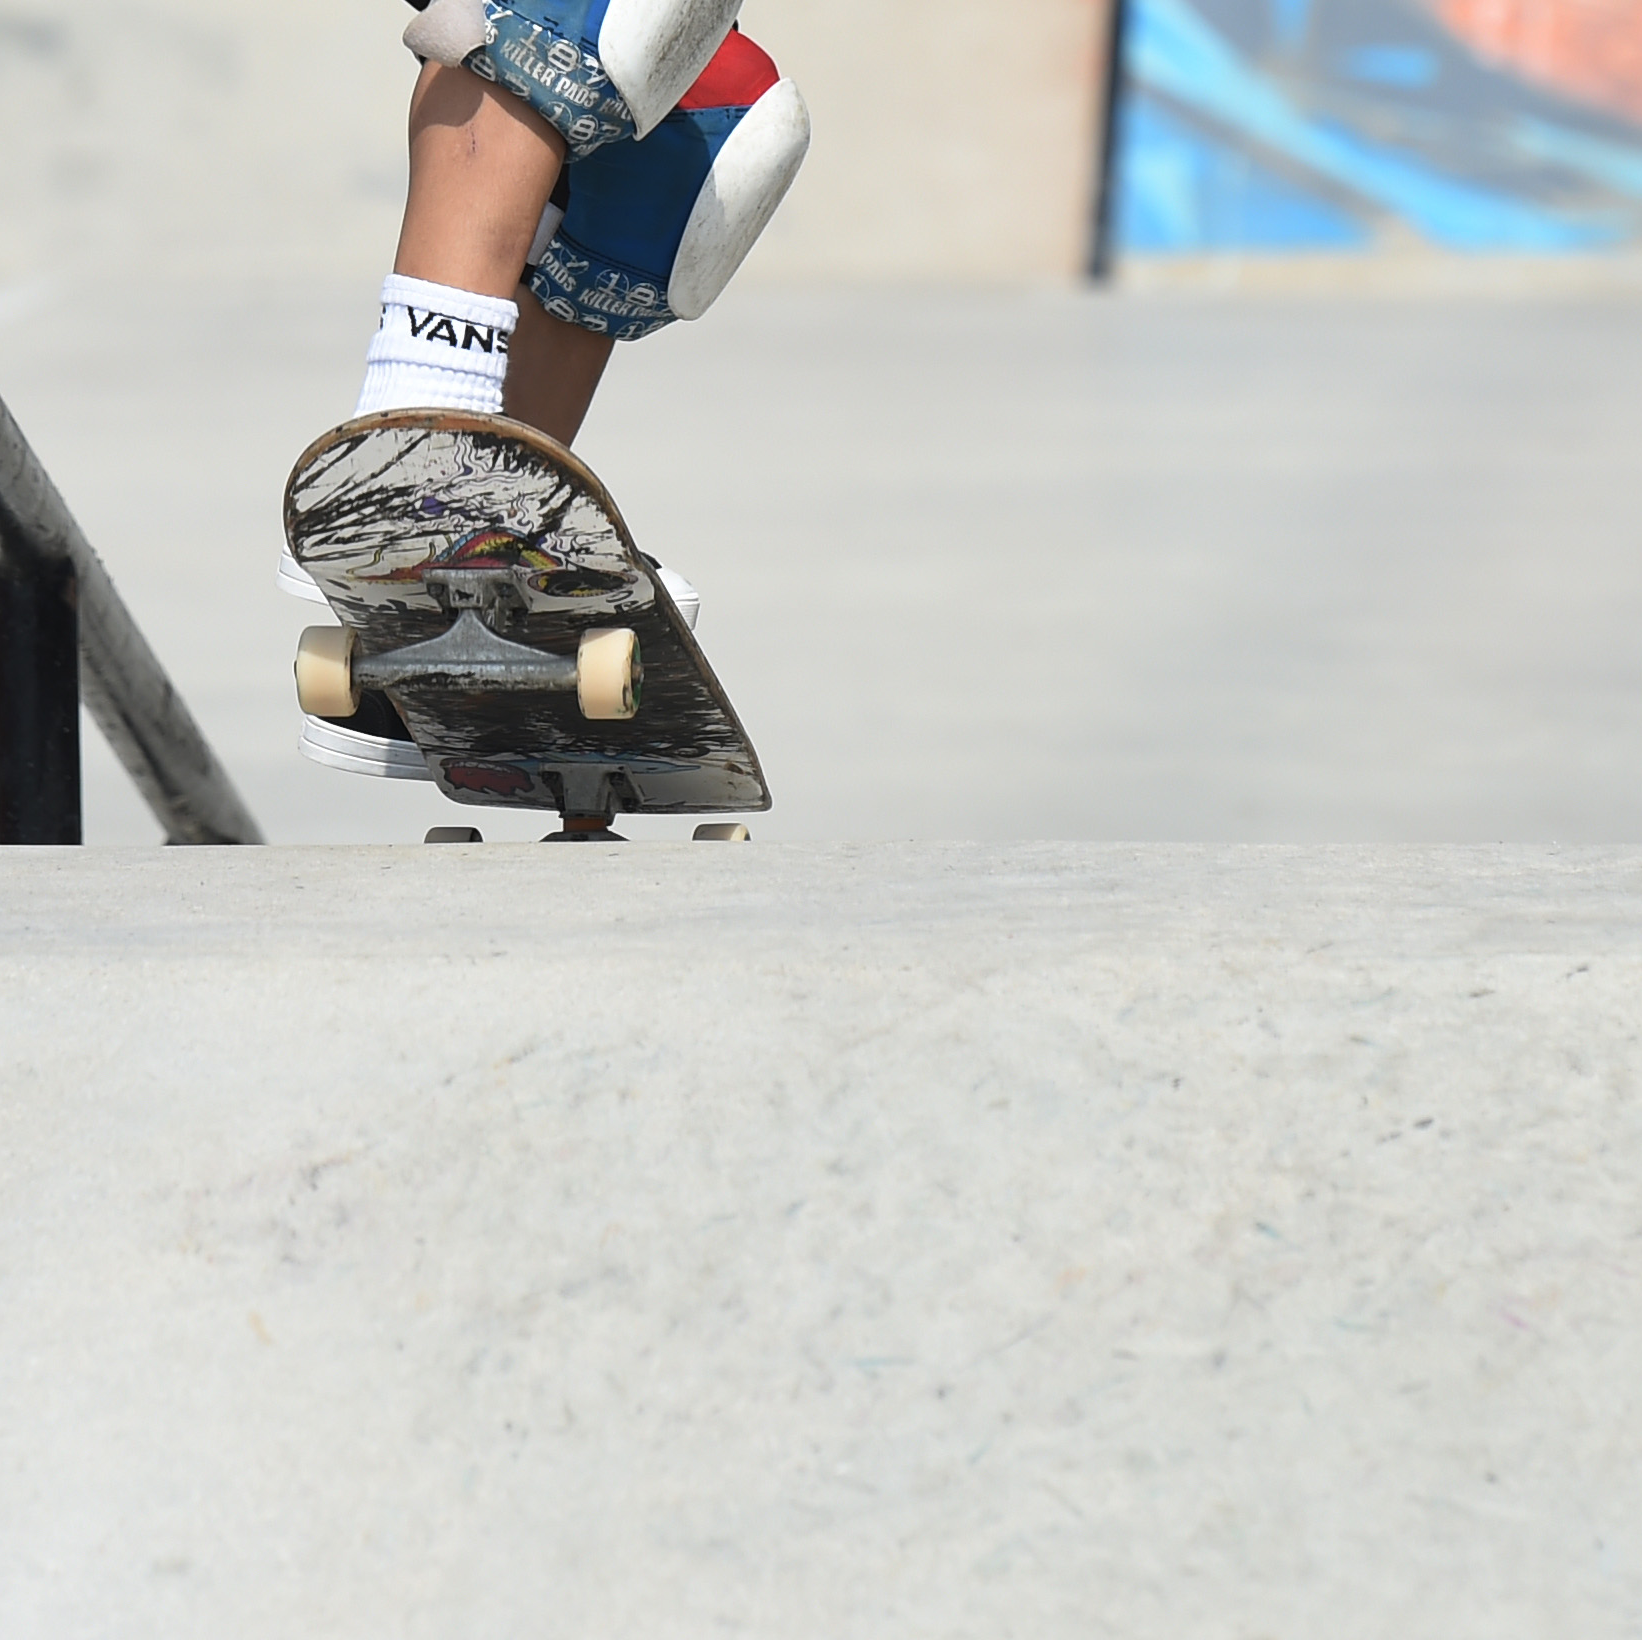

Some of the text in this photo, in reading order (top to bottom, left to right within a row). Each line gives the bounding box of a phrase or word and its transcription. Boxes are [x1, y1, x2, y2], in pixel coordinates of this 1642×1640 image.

[499, 38, 557, 87] KILLER
[555, 76, 600, 109] PADS
[539, 251, 578, 293] PADS
[577, 288, 632, 317] KILLER
[407, 304, 509, 354] VANS
